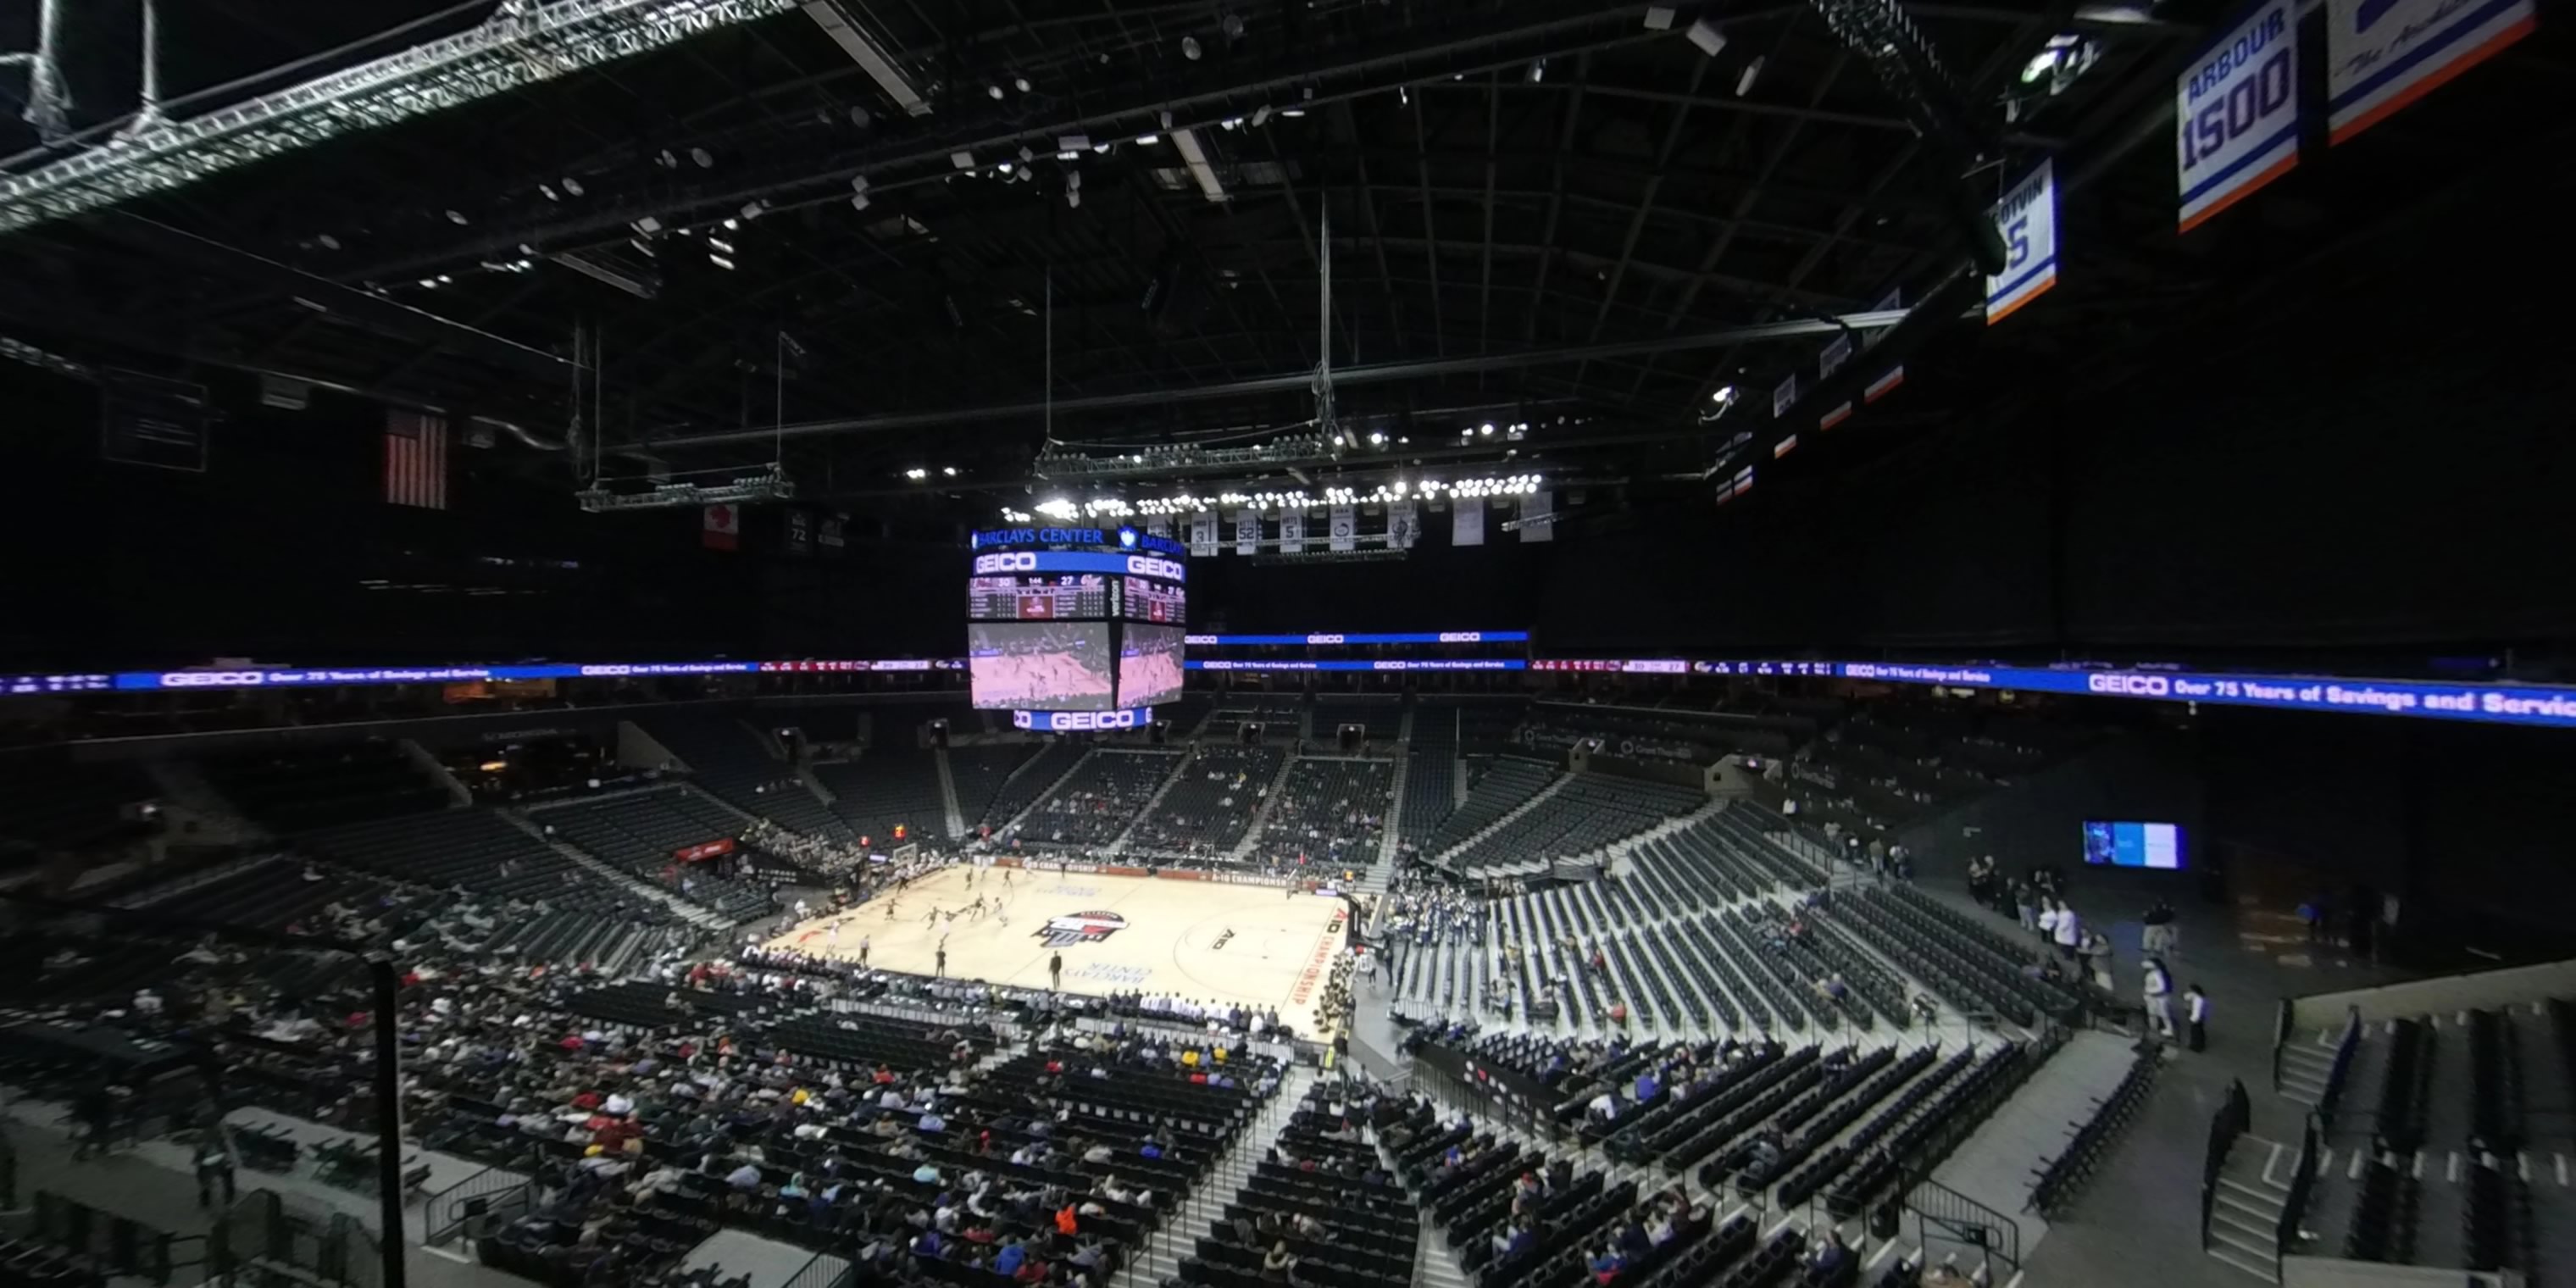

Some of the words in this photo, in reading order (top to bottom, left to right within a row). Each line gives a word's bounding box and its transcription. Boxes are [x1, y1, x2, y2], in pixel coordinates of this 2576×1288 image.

[2188, 7, 2285, 106] ARBOUR
[2182, 46, 2291, 173] 1500
[2000, 175, 2043, 225] OTVIN
[2007, 214, 2029, 269] 5
[978, 530, 1035, 547] BARCLAYS
[1040, 527, 1104, 544] CENTER
[1196, 530, 1204, 544] 3
[1238, 528, 1255, 541] 52
[1285, 525, 1295, 538] 5
[976, 552, 1036, 575] GEICO
[1127, 555, 1182, 581] GEICO
[998, 578, 1010, 586] 30
[1061, 576, 1074, 586] 27
[1110, 580, 1120, 617] verizon
[1185, 635, 1218, 644] GEICO
[1307, 635, 1344, 644] GEICO
[1439, 632, 1480, 642] GEICO
[581, 664, 630, 675] GEICO
[1203, 661, 1232, 669] GEICO
[1374, 661, 1407, 669] GEICO
[1846, 664, 1875, 677] GEICO
[162, 671, 263, 686] GEICO
[2089, 674, 2168, 696] GEICO
[2174, 680, 2211, 695] Over
[2214, 681, 2240, 697] 75
[2243, 682, 2296, 700] Years
[2299, 686, 2321, 702] of
[2327, 686, 2415, 711] Savings
[2423, 691, 2475, 711] and
[1051, 710, 1135, 730] GEICO
[1212, 874, 1229, 883] A-10
[1292, 935, 1335, 1006] CHAMPIONSHIP
